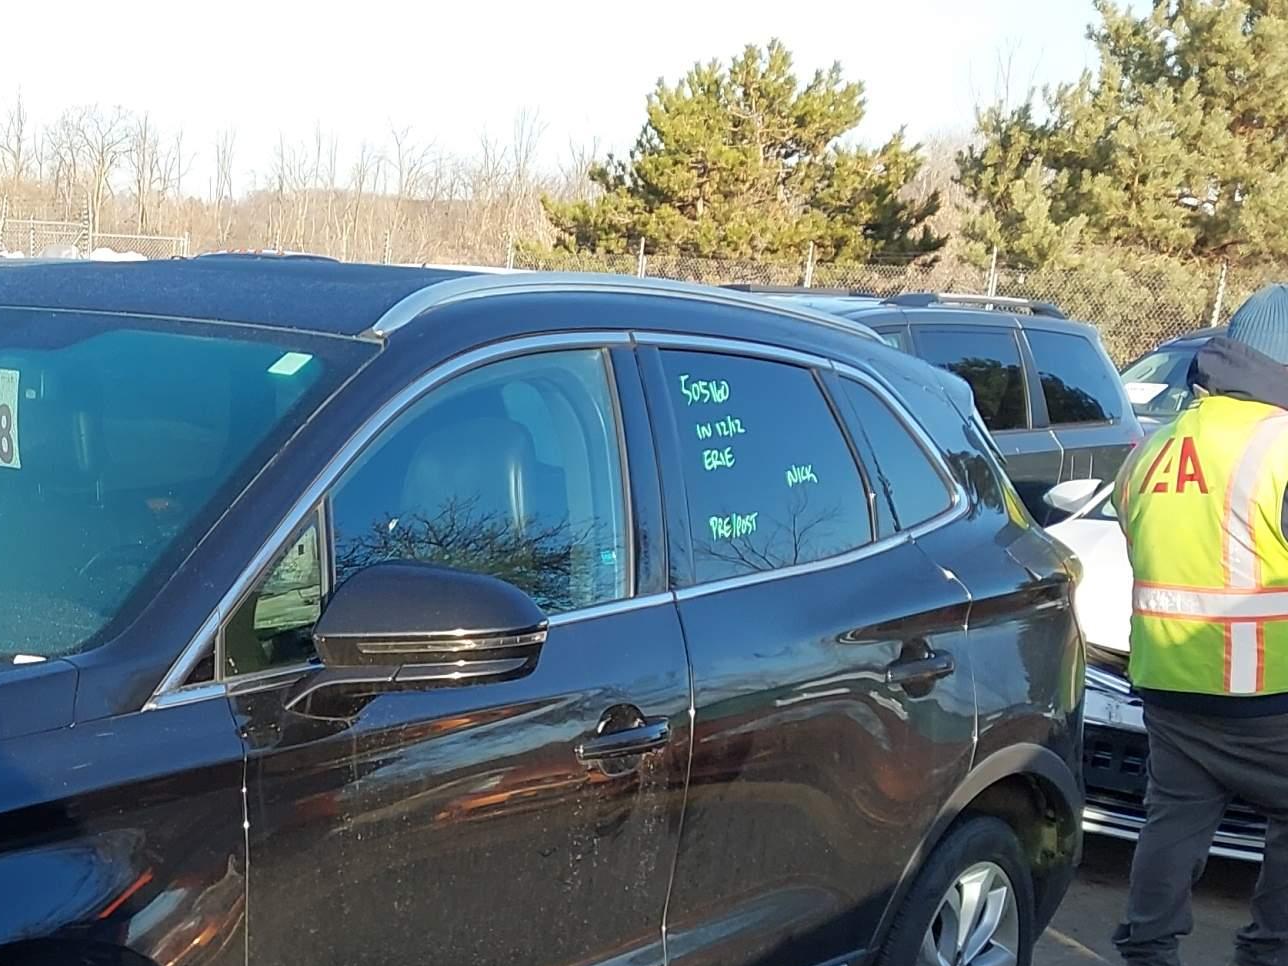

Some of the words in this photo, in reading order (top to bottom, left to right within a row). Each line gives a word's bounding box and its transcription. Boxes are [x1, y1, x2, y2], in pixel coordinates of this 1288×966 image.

[696, 421, 712, 440] IN
[716, 415, 745, 438] 12/12
[703, 447, 735, 471] ERIE
[787, 465, 818, 488] NICK
[710, 512, 758, 542] PRE/POST
